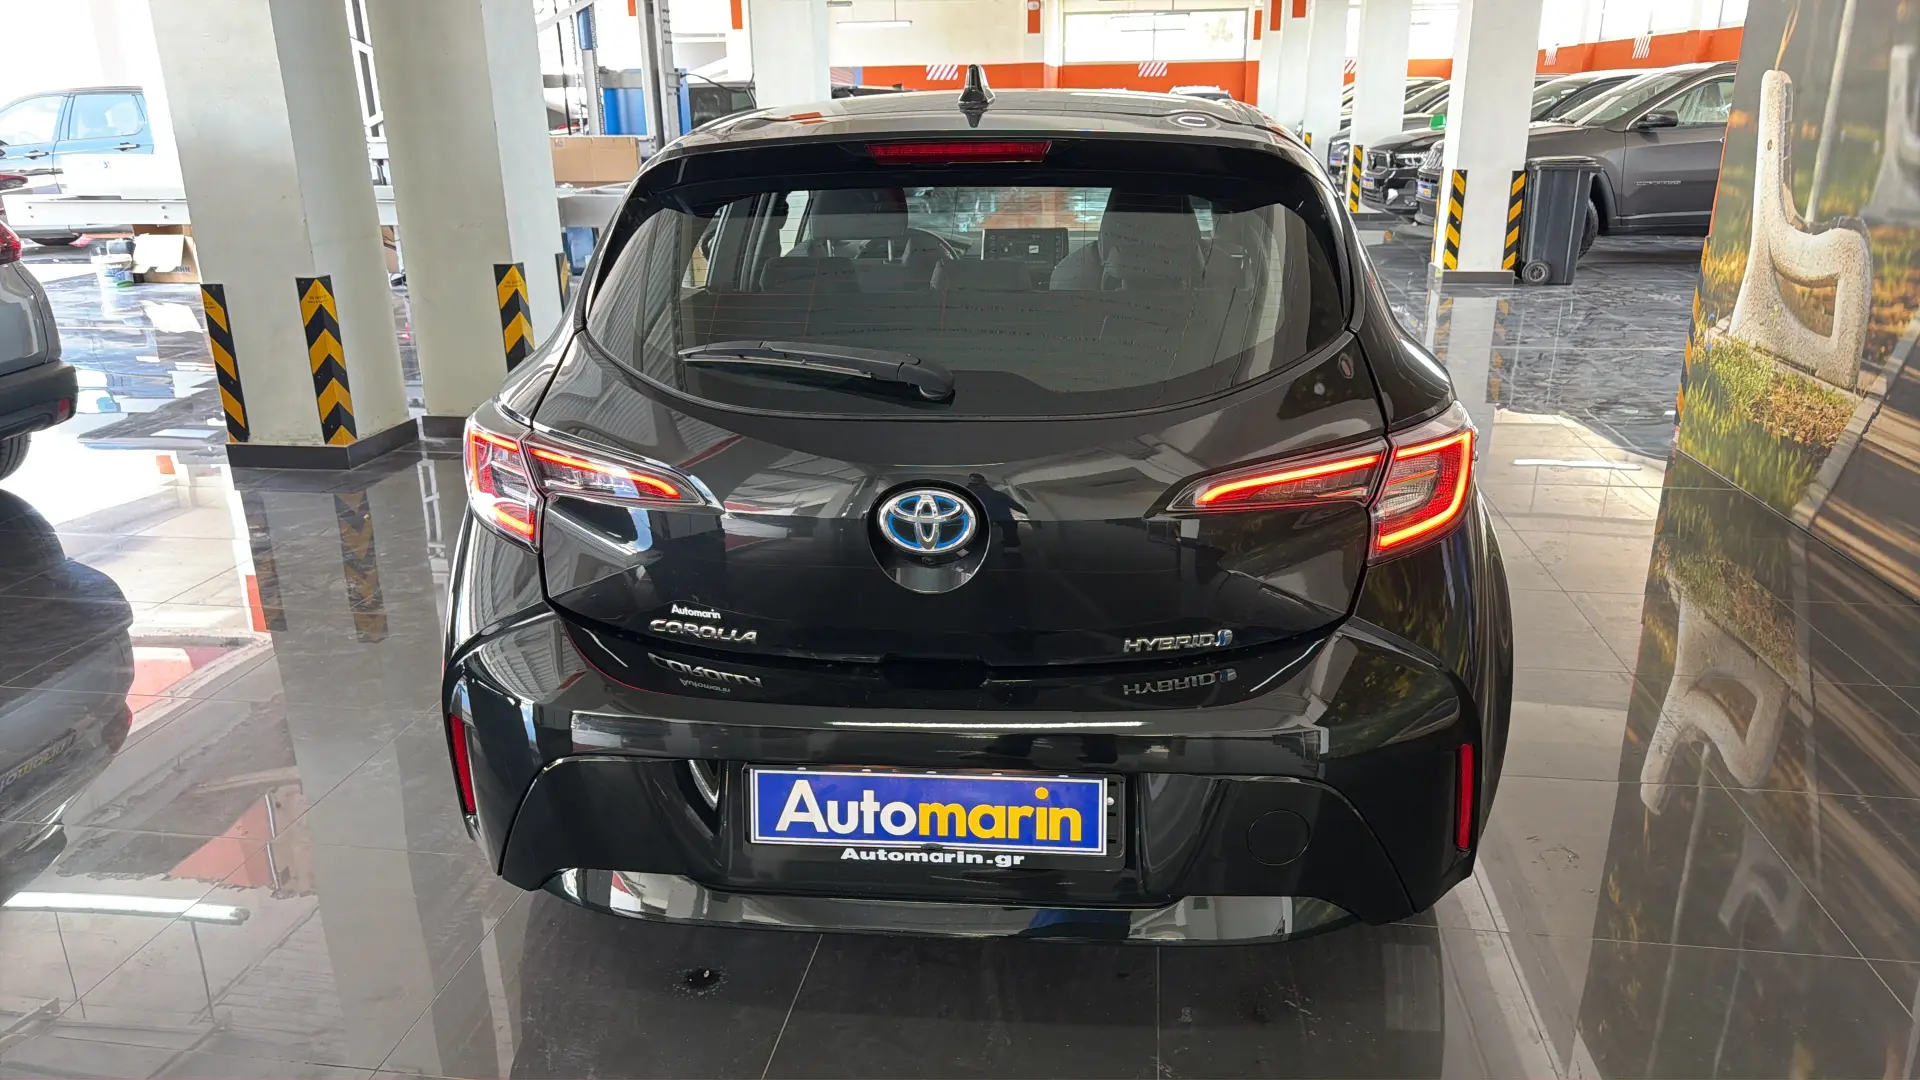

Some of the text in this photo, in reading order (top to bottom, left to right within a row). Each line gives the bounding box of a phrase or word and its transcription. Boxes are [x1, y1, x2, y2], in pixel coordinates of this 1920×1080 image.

[671, 604, 721, 619] Automarin
[650, 618, 758, 643] COROLLA
[1123, 634, 1217, 652] HYBRID
[776, 779, 1082, 842] Automarin
[840, 848, 1025, 868] Automarin.gr
